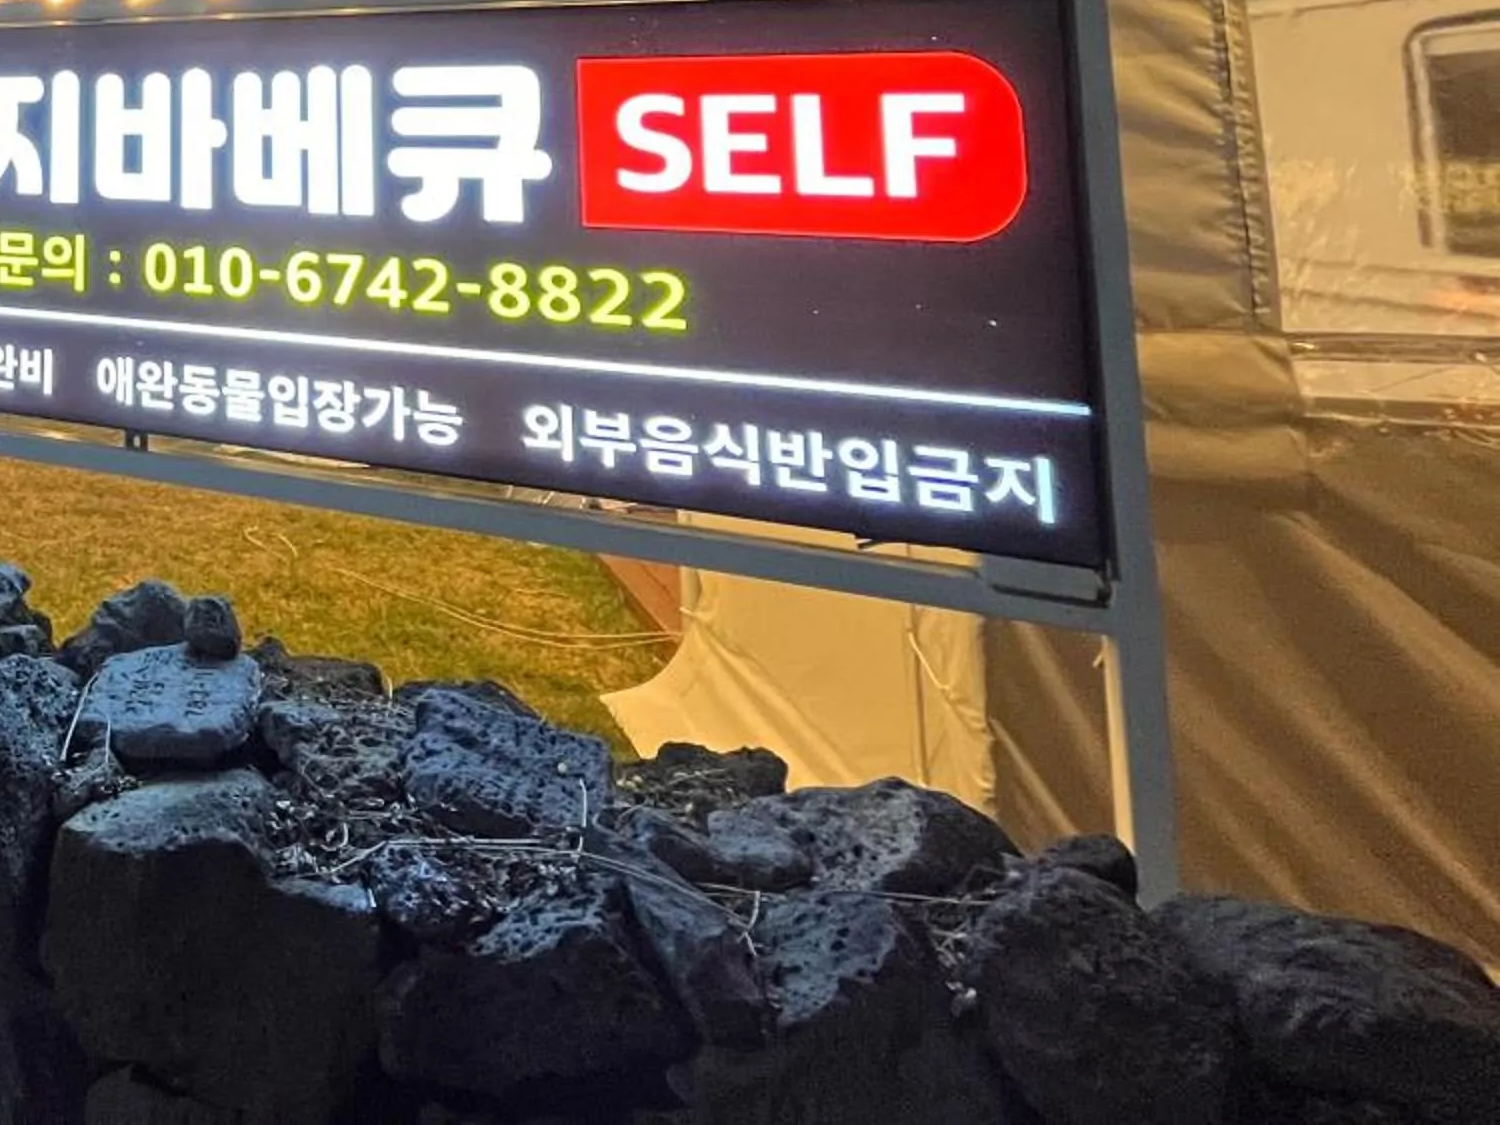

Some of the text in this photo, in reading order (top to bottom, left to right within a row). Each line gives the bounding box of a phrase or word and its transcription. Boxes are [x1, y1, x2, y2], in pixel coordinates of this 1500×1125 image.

[615, 92, 966, 199] SELF
[144, 242, 688, 331] 010-6742-8822
[97, 357, 464, 447] 애완동물입장가능
[523, 405, 1056, 525] 외부음식반입금지
